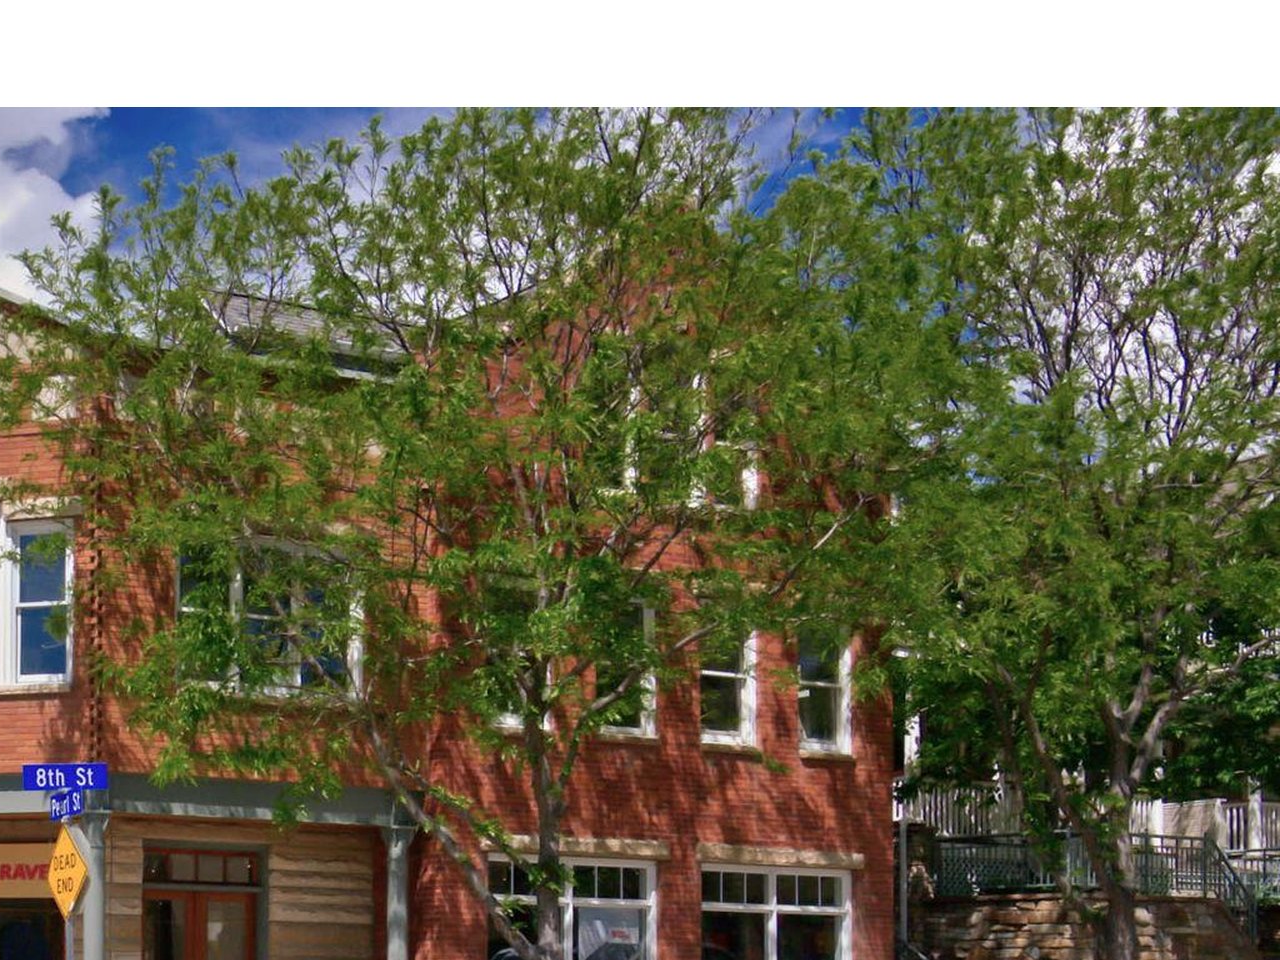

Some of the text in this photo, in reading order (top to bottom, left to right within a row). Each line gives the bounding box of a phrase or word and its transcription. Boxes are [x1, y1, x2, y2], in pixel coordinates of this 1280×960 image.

[36, 767, 94, 787] 8th St
[72, 792, 81, 812] St
[53, 853, 77, 871] DEAD
[57, 877, 74, 894] END
